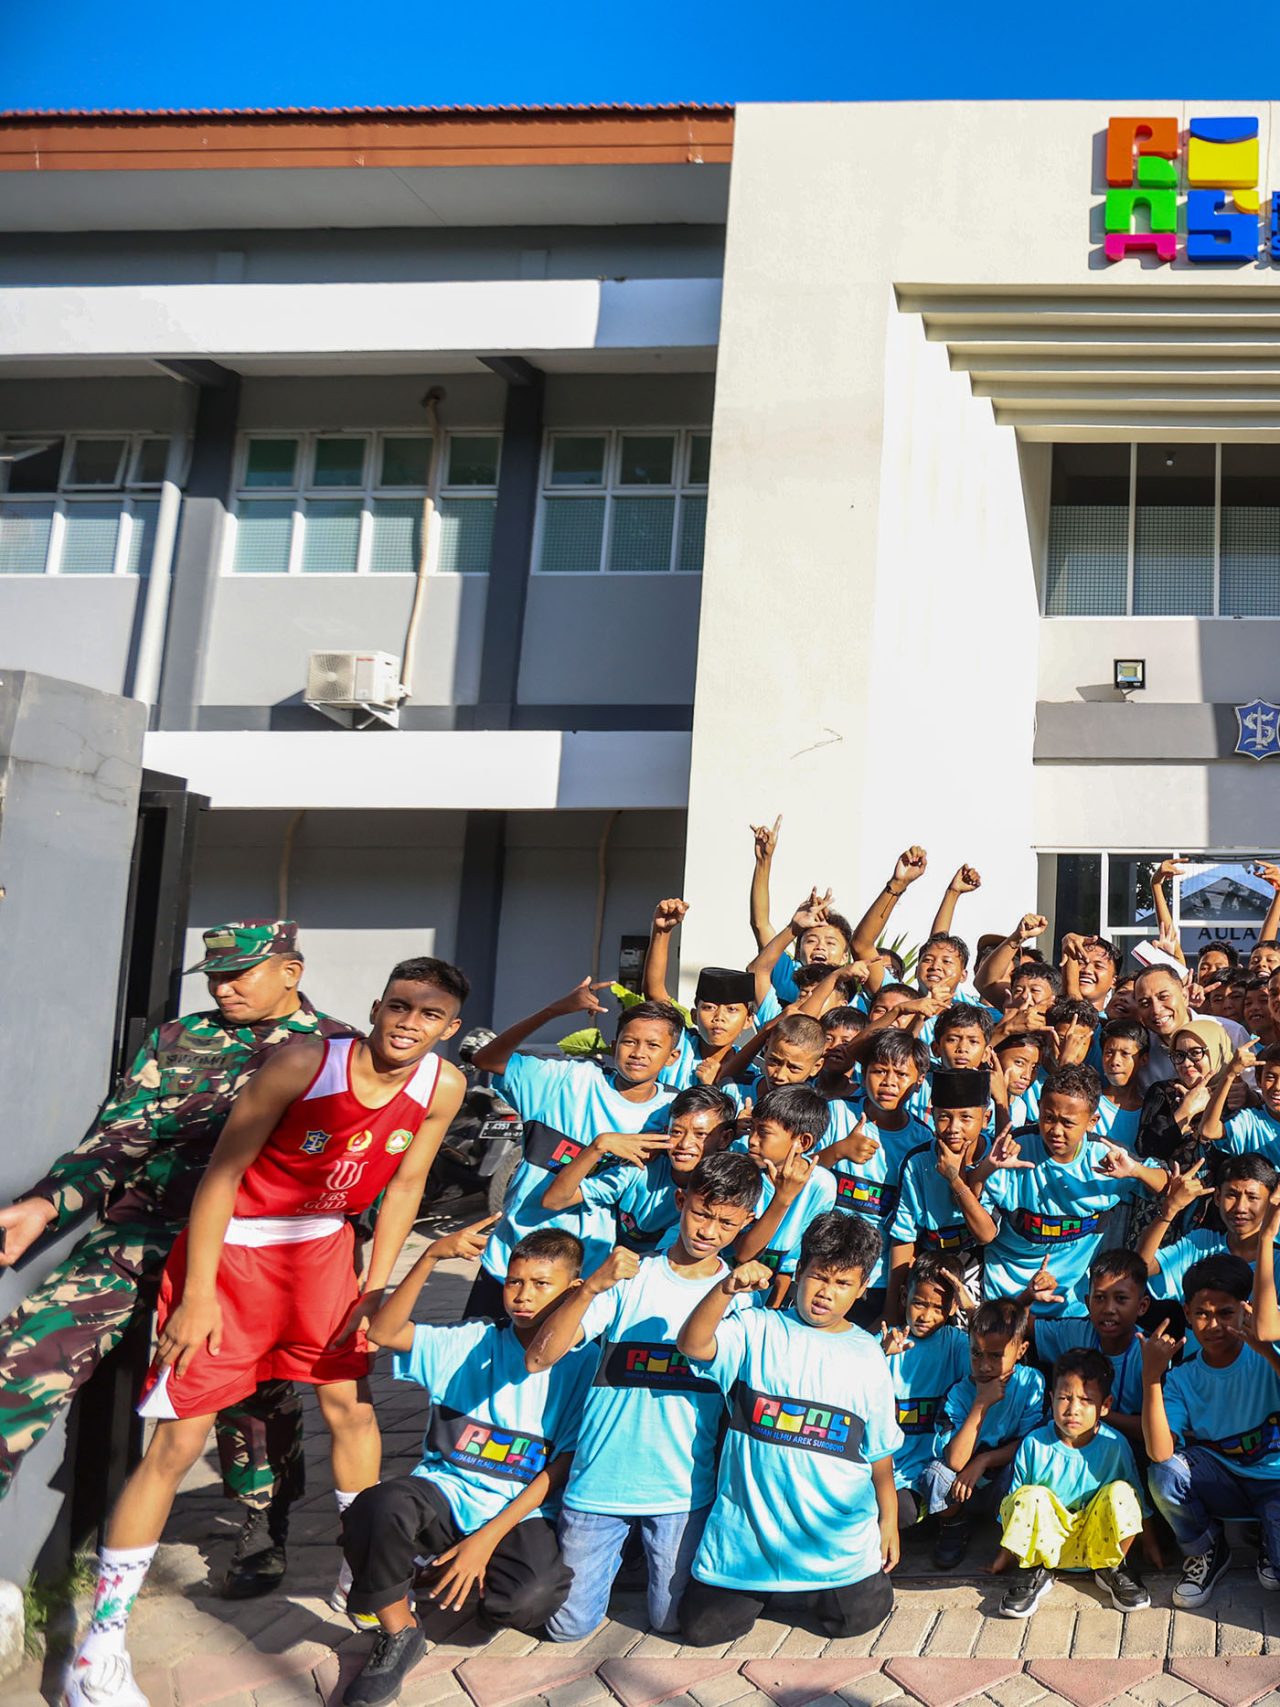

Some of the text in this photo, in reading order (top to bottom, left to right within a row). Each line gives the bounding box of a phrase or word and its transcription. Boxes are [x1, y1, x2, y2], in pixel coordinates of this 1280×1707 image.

[1198, 927, 1257, 940] AULA
[304, 1201, 347, 1210] GOLD
[793, 1436, 812, 1446] AREK
